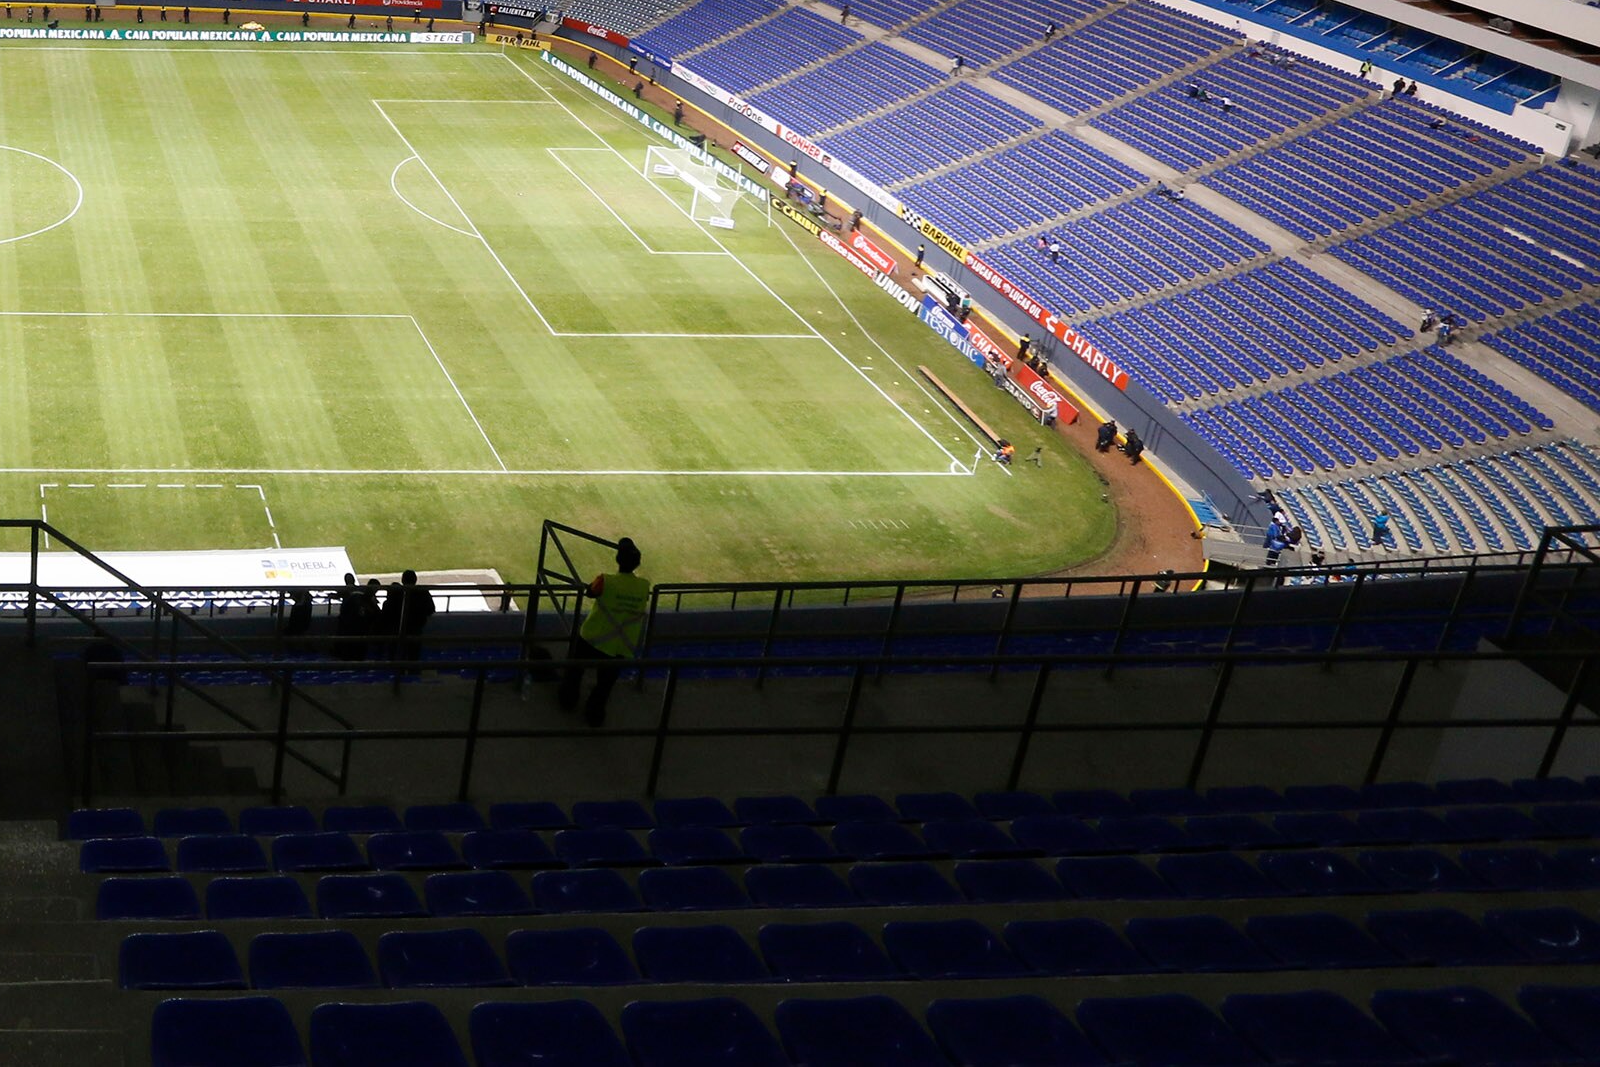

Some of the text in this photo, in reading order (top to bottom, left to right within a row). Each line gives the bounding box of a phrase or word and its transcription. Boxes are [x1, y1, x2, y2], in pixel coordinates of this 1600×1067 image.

[498, 6, 536, 18] CALIENTE.MX
[0, 28, 47, 39] POPULAR
[49, 29, 104, 40] MEXICANA
[152, 30, 198, 41] POPULAR
[200, 31, 256, 41] MEXICANA
[303, 32, 349, 42] POPULAR
[351, 33, 406, 43] MEXICANA
[496, 35, 540, 48] BARAHL
[587, 25, 608, 39] Coca-Cola
[567, 66, 600, 94] POPULAR
[600, 86, 639, 119] MEXICANA
[785, 131, 821, 159] GONHER
[820, 230, 848, 258] Office
[922, 223, 964, 259] BARDAHL
[972, 261, 992, 284] LUCAS
[990, 274, 1003, 290] OIL
[876, 272, 921, 313] UNION
[1009, 289, 1042, 319] LUCAS OIL
[1062, 329, 1123, 384] CHARLY
[290, 561, 336, 570] PUEBLA
